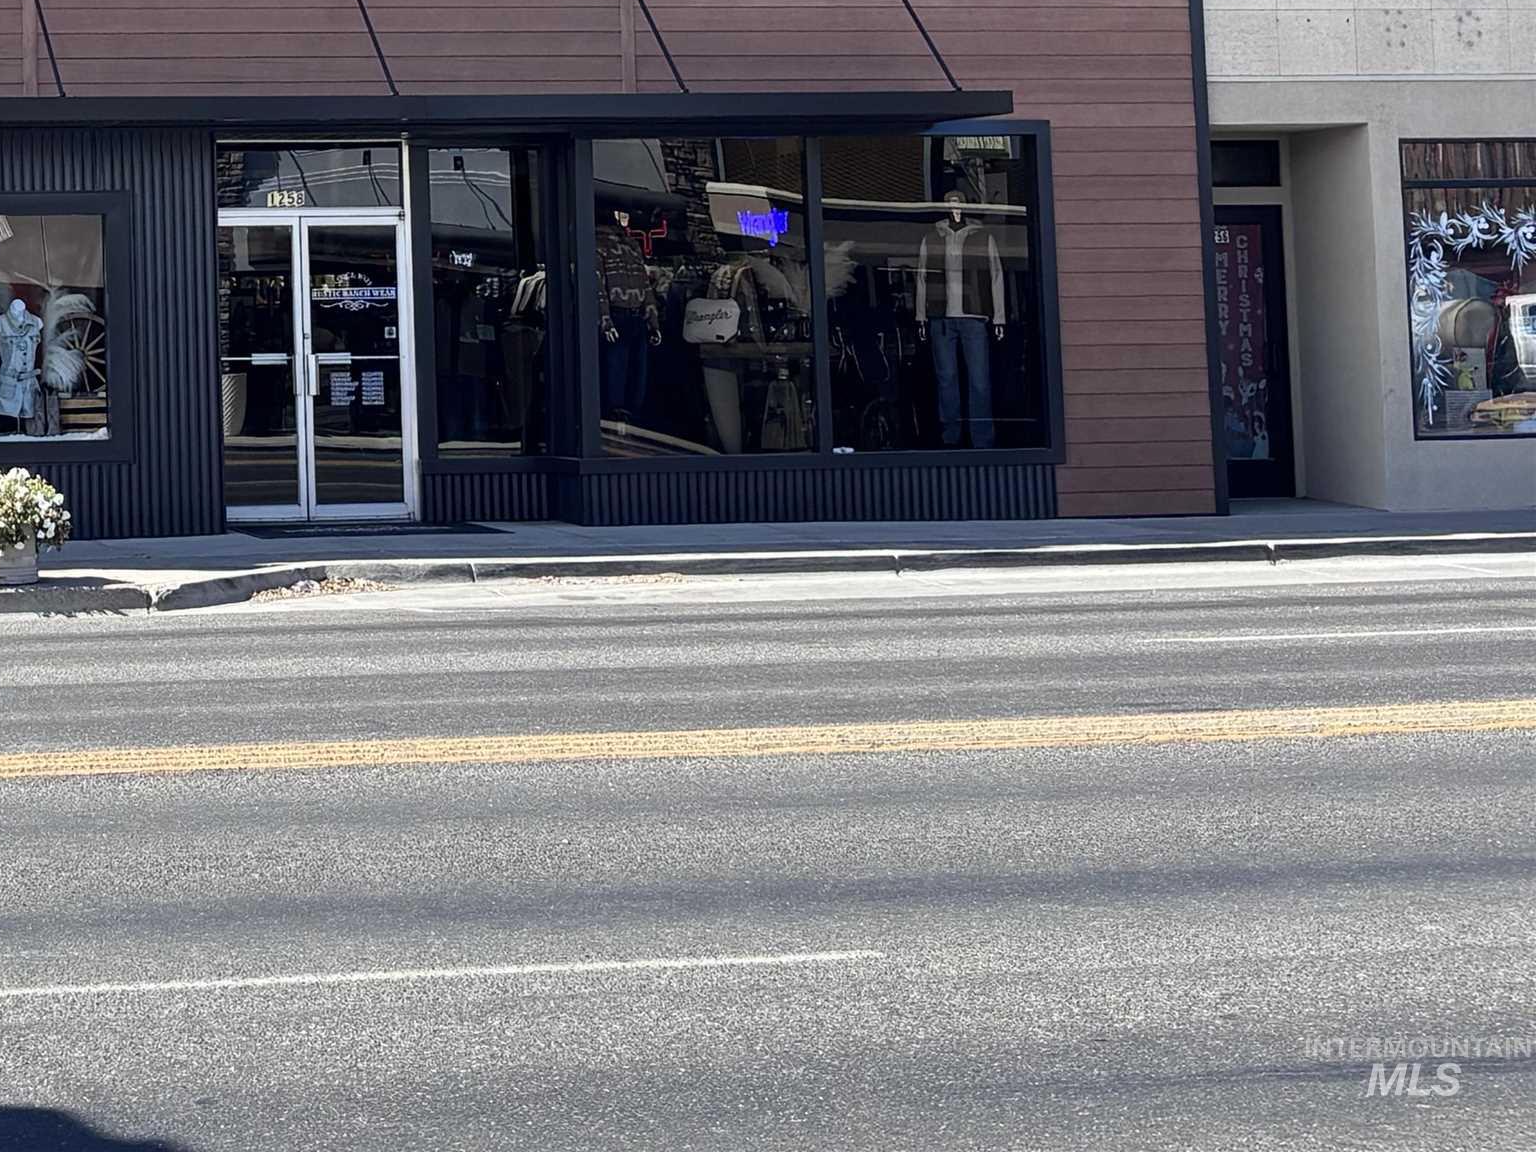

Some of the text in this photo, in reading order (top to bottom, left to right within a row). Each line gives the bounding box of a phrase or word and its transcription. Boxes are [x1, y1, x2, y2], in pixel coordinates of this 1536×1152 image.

[270, 191, 304, 205] 1258
[1215, 252, 1230, 337] MERRY
[1235, 235, 1253, 367] CHRISTMAS
